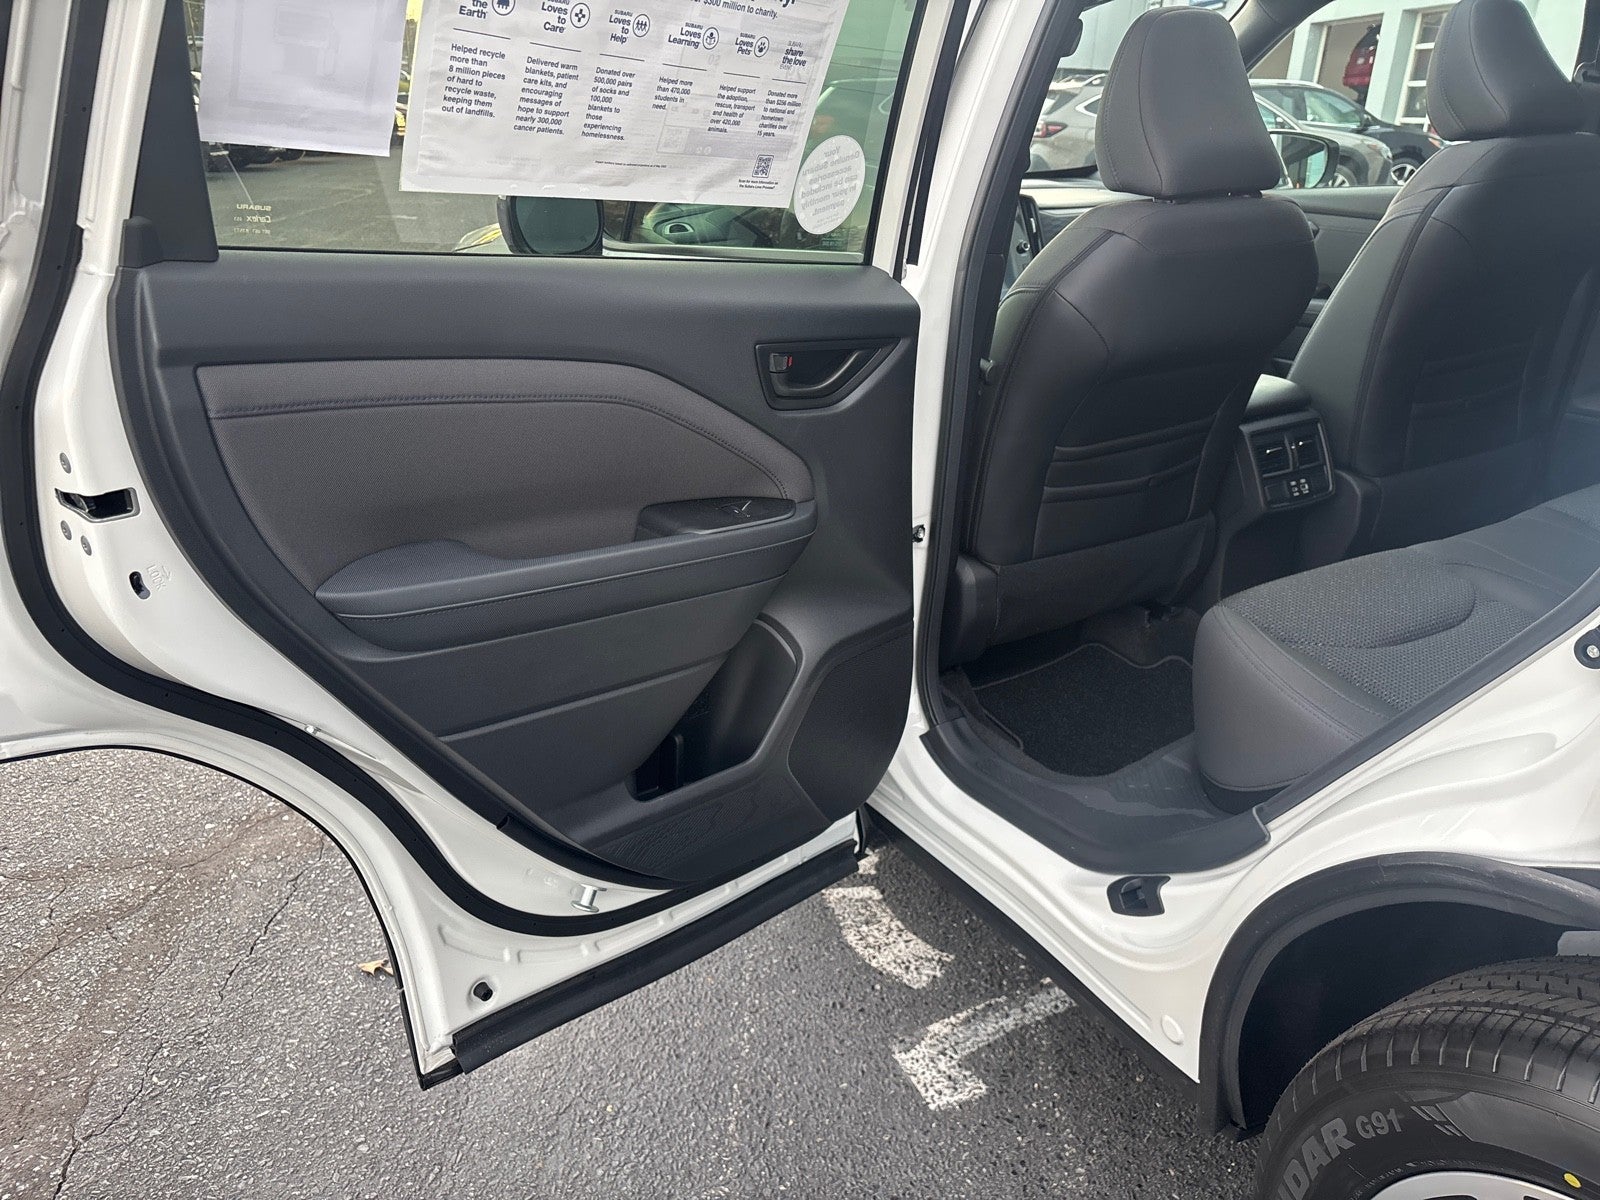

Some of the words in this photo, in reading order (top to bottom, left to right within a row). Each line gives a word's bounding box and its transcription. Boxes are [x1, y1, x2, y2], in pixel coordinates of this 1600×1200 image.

[459, 5, 487, 19] Earth
[541, 2, 568, 15] Loves
[614, 9, 633, 17] SUBARU
[722, 1, 745, 12] million
[747, 5, 754, 14] to
[755, 6, 778, 20] charity.
[557, 15, 566, 24] to
[609, 15, 631, 26] Loves
[544, 21, 565, 33] Care
[621, 26, 629, 35] to
[610, 33, 627, 44] Help
[680, 27, 701, 39] Loves
[668, 35, 700, 49] Learning
[735, 37, 754, 48] Loves
[451, 43, 478, 55] Helped
[479, 49, 506, 60] recycle
[737, 47, 751, 55] Pets
[785, 47, 803, 57] share
[450, 55, 469, 64] more
[471, 58, 487, 67] than
[527, 56, 559, 68] Delivered
[782, 56, 793, 65] the
[793, 57, 807, 67] love
[455, 67, 480, 76] million
[482, 71, 506, 80] pieces
[525, 66, 555, 78] blankets,
[556, 72, 579, 81] patient
[596, 67, 620, 77] Donated
[457, 76, 473, 85] hard
[523, 77, 538, 85] care
[540, 79, 553, 88] kits,
[594, 76, 616, 86] 500,000
[659, 76, 678, 86] Helped
[445, 85, 472, 95] recycle
[473, 90, 497, 100] waste,
[521, 87, 563, 99] encouraging
[618, 89, 629, 97] and
[657, 85, 669, 93] than
[719, 85, 737, 93] Helped
[767, 90, 786, 98] Donated
[443, 95, 472, 106] keeping
[474, 98, 492, 107] them
[519, 97, 553, 107] messages
[590, 95, 613, 104] 100,000
[654, 94, 678, 103] students
[517, 105, 535, 114] hope
[544, 109, 569, 118] support
[588, 104, 613, 113] blankets
[715, 102, 733, 110] rescue,
[465, 108, 495, 118] landfills.
[515, 115, 536, 124] nearly
[537, 117, 562, 126] 300,000
[536, 126, 564, 135] patients.
[583, 122, 621, 133] experiencing
[581, 130, 624, 141] homelessness.
[146, 564, 166, 591] LOCK
[1355, 1108, 1402, 1139] G91
